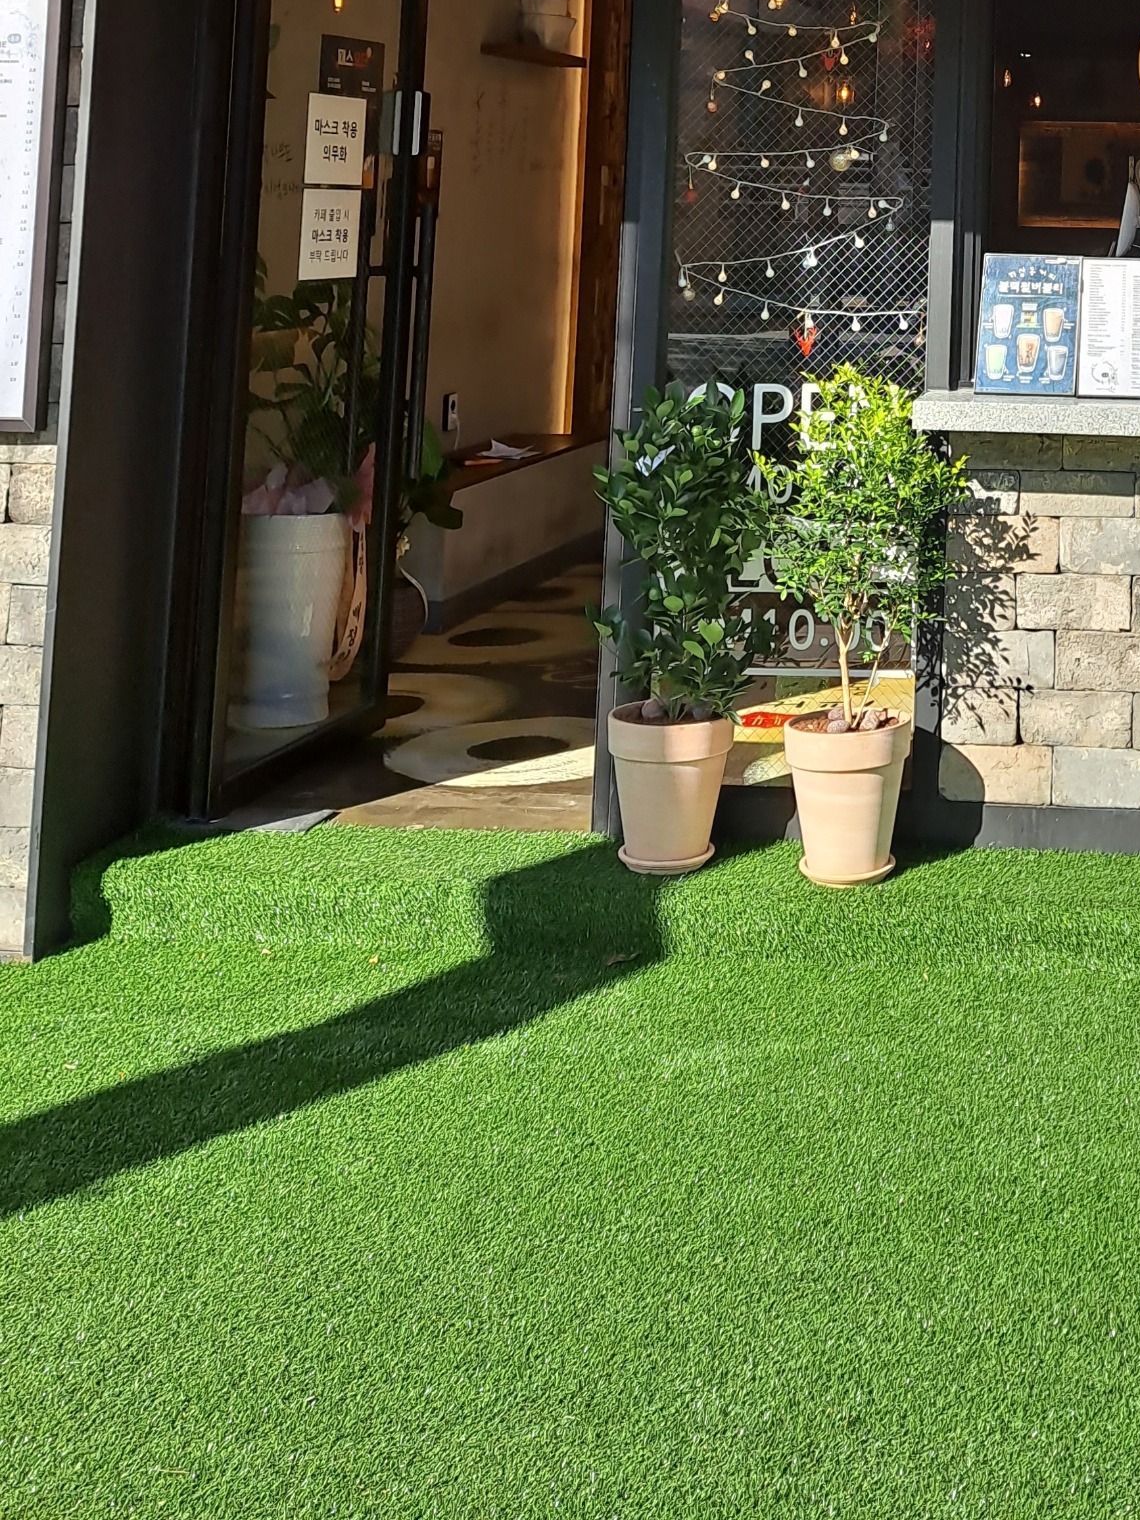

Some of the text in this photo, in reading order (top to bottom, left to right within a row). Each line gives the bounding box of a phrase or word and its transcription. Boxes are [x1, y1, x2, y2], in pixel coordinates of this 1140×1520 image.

[314, 118, 358, 138] 마스크 착용
[322, 144, 347, 163] 의무화
[311, 227, 348, 243] 마스크 착용
